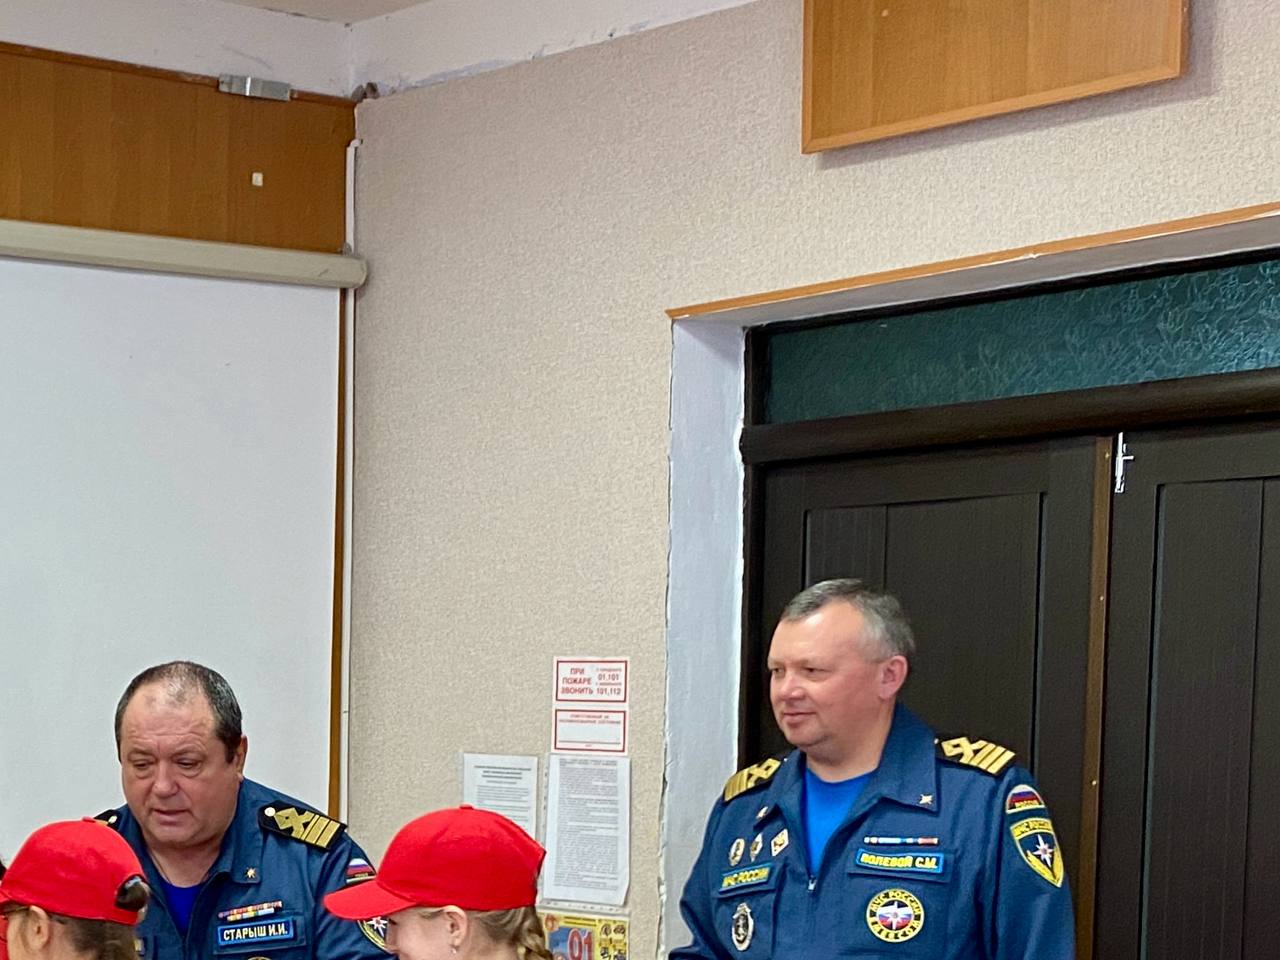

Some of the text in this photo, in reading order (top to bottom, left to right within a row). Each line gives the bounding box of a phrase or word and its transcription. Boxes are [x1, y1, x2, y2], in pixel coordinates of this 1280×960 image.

[562, 677, 592, 685] ПОЖАРЕ
[561, 687, 594, 695] ЗВОНИТЬ
[223, 923, 288, 941] СТАРЫШ И.И.
